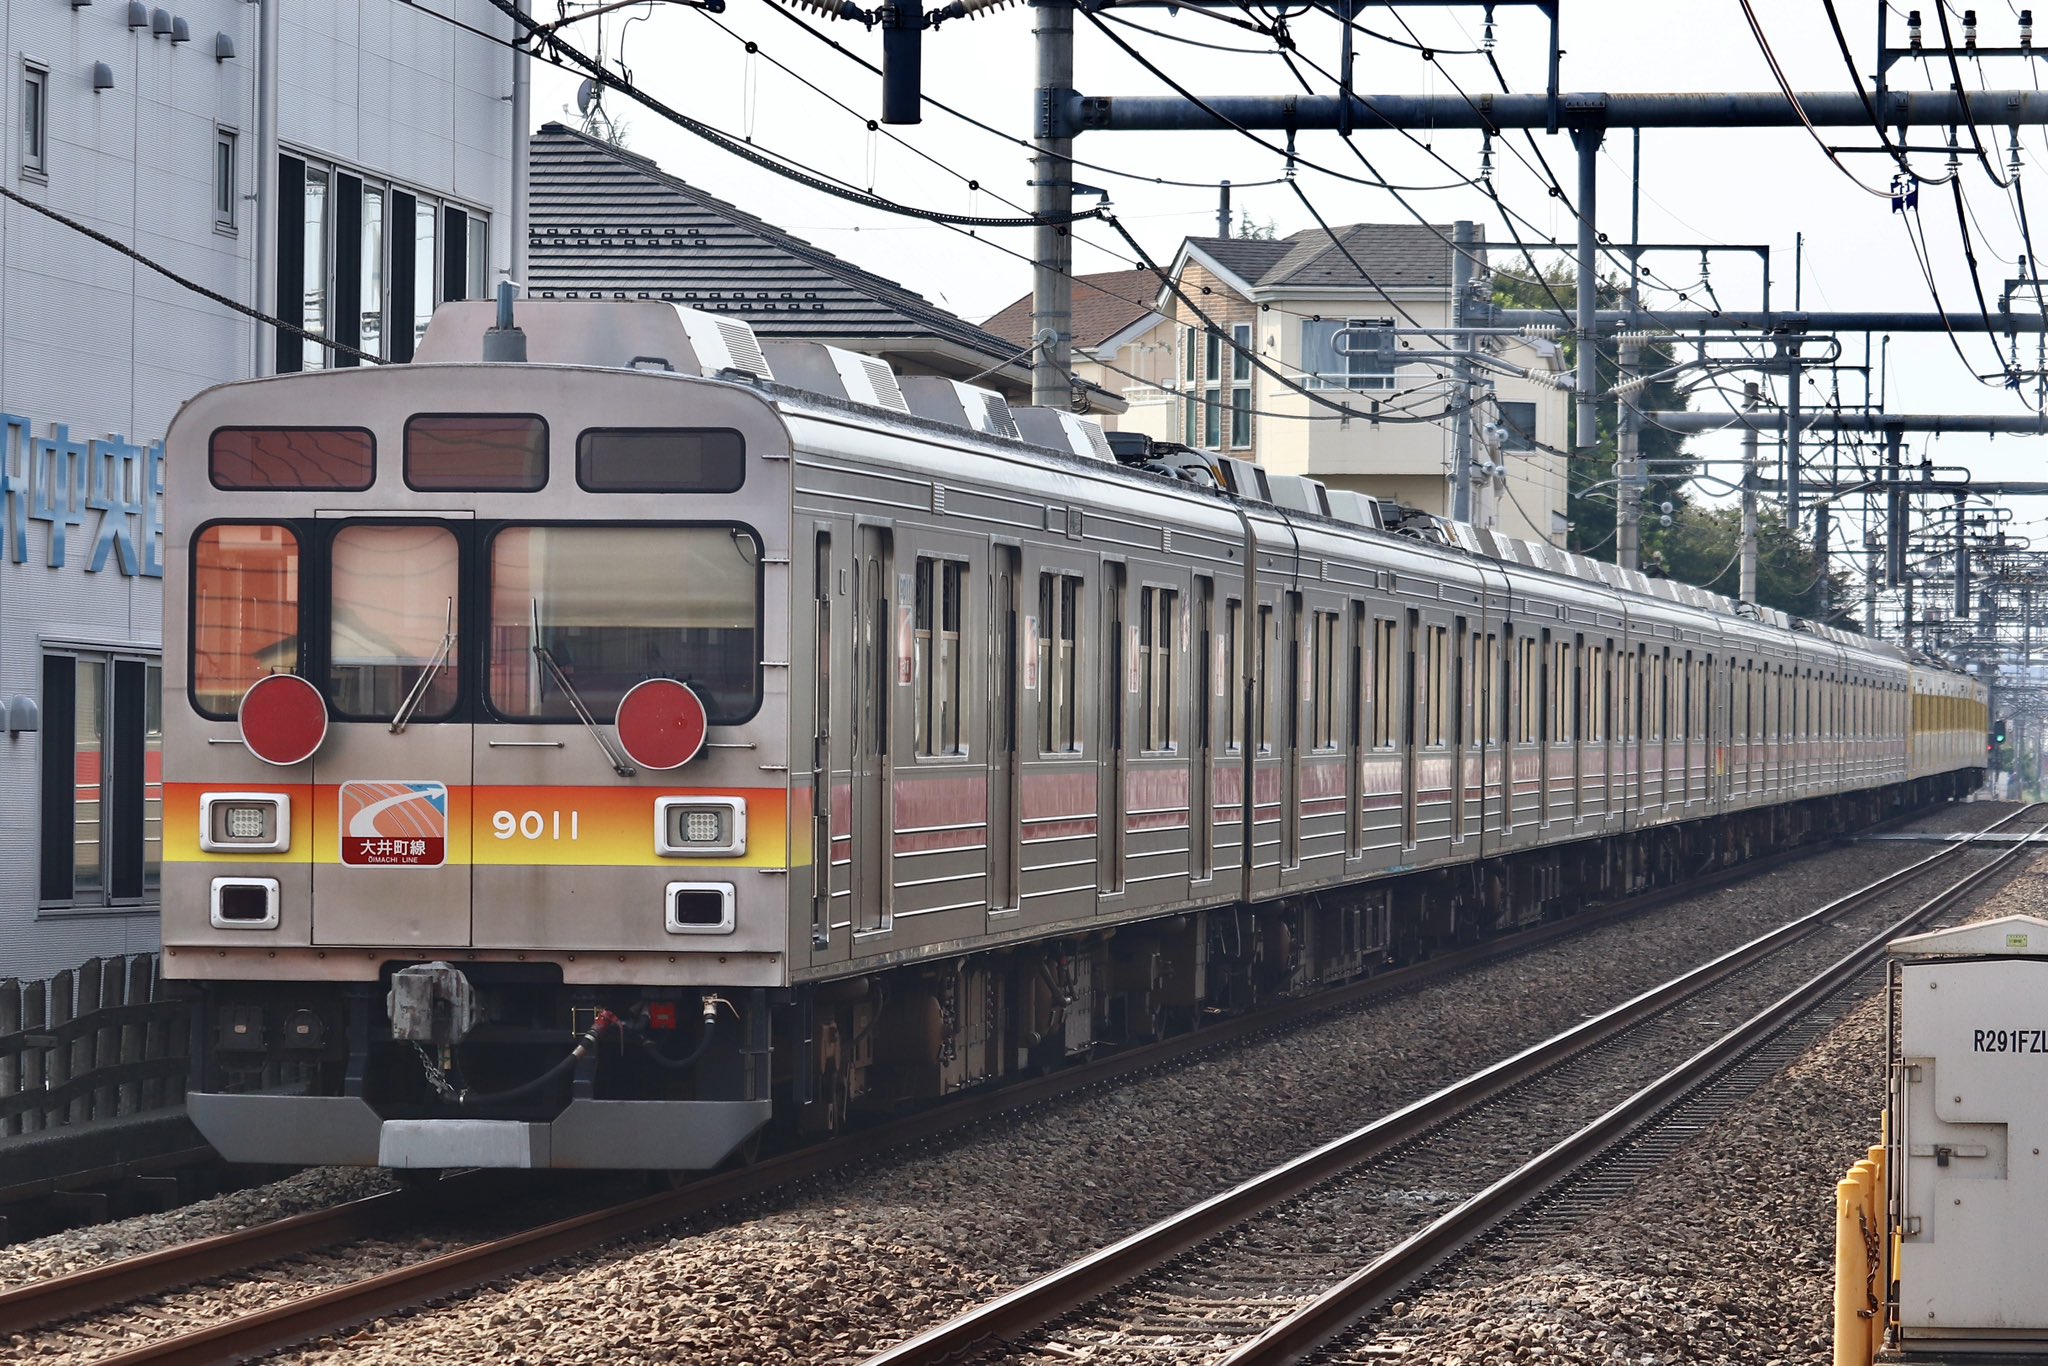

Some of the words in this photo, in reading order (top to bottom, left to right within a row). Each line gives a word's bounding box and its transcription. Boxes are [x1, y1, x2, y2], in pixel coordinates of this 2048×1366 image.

[492, 810, 578, 840] 9011
[360, 839, 426, 856] 大井町線
[1974, 1029, 2048, 1053] R291FZL
